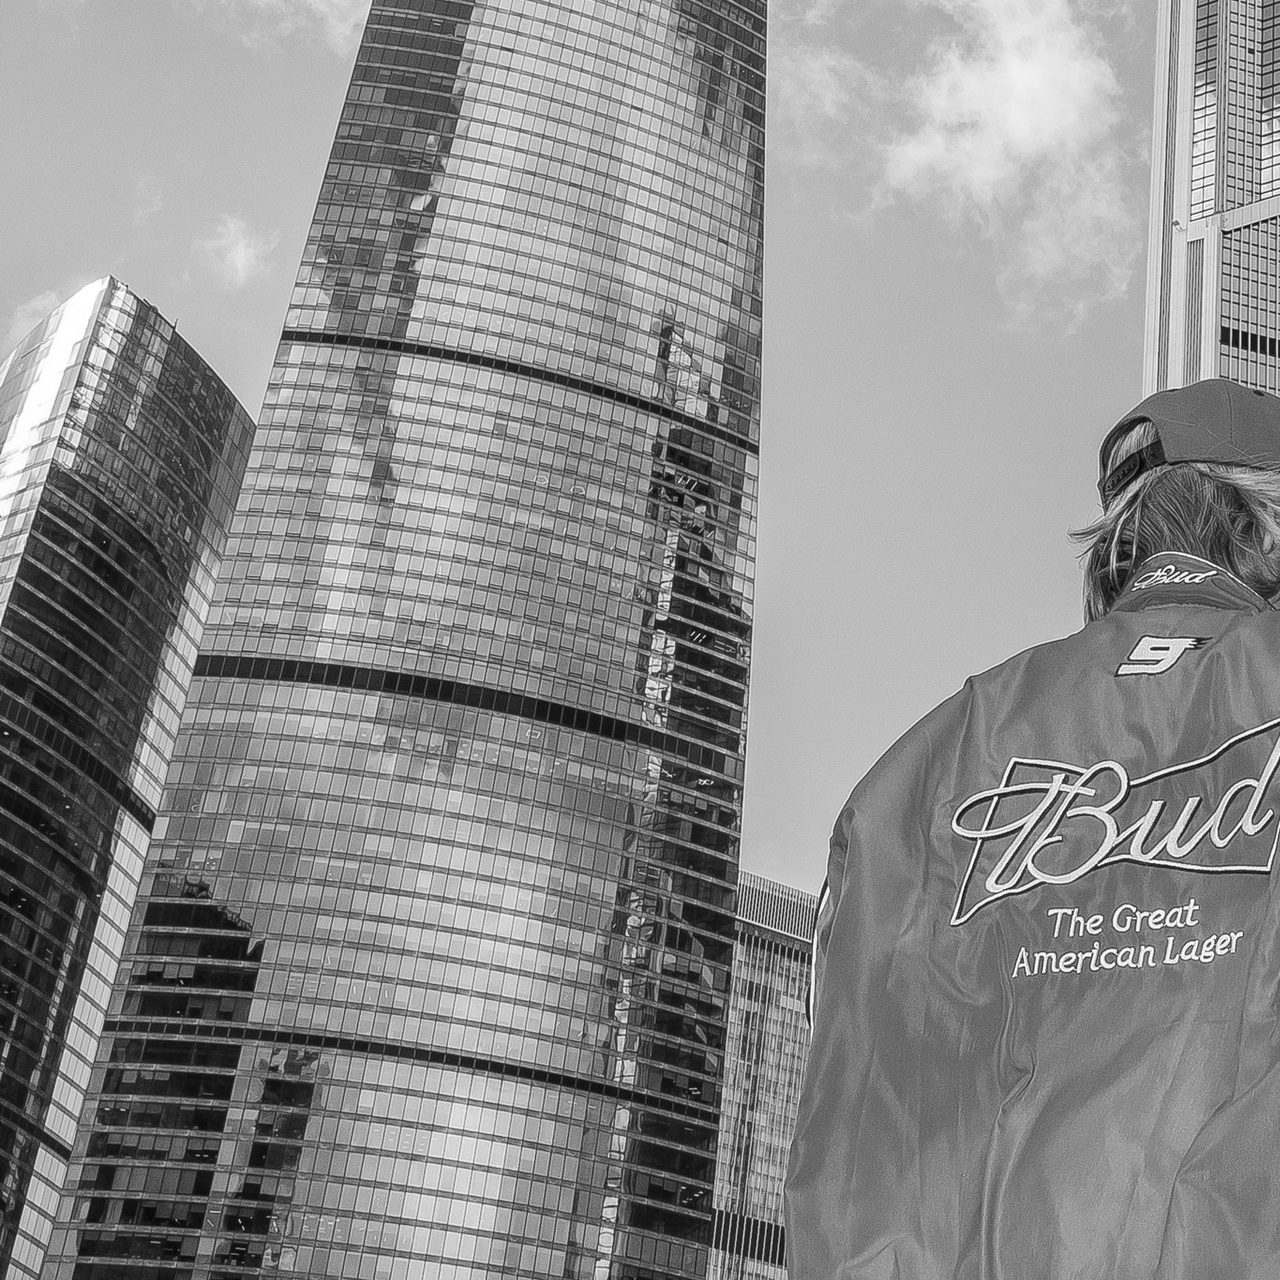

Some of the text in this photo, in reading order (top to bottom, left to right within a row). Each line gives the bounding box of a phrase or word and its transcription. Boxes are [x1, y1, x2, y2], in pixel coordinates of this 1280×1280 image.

[1131, 565, 1218, 591] Bud
[1047, 898, 1200, 938] The Great
[1011, 931, 1244, 978] American Lager
